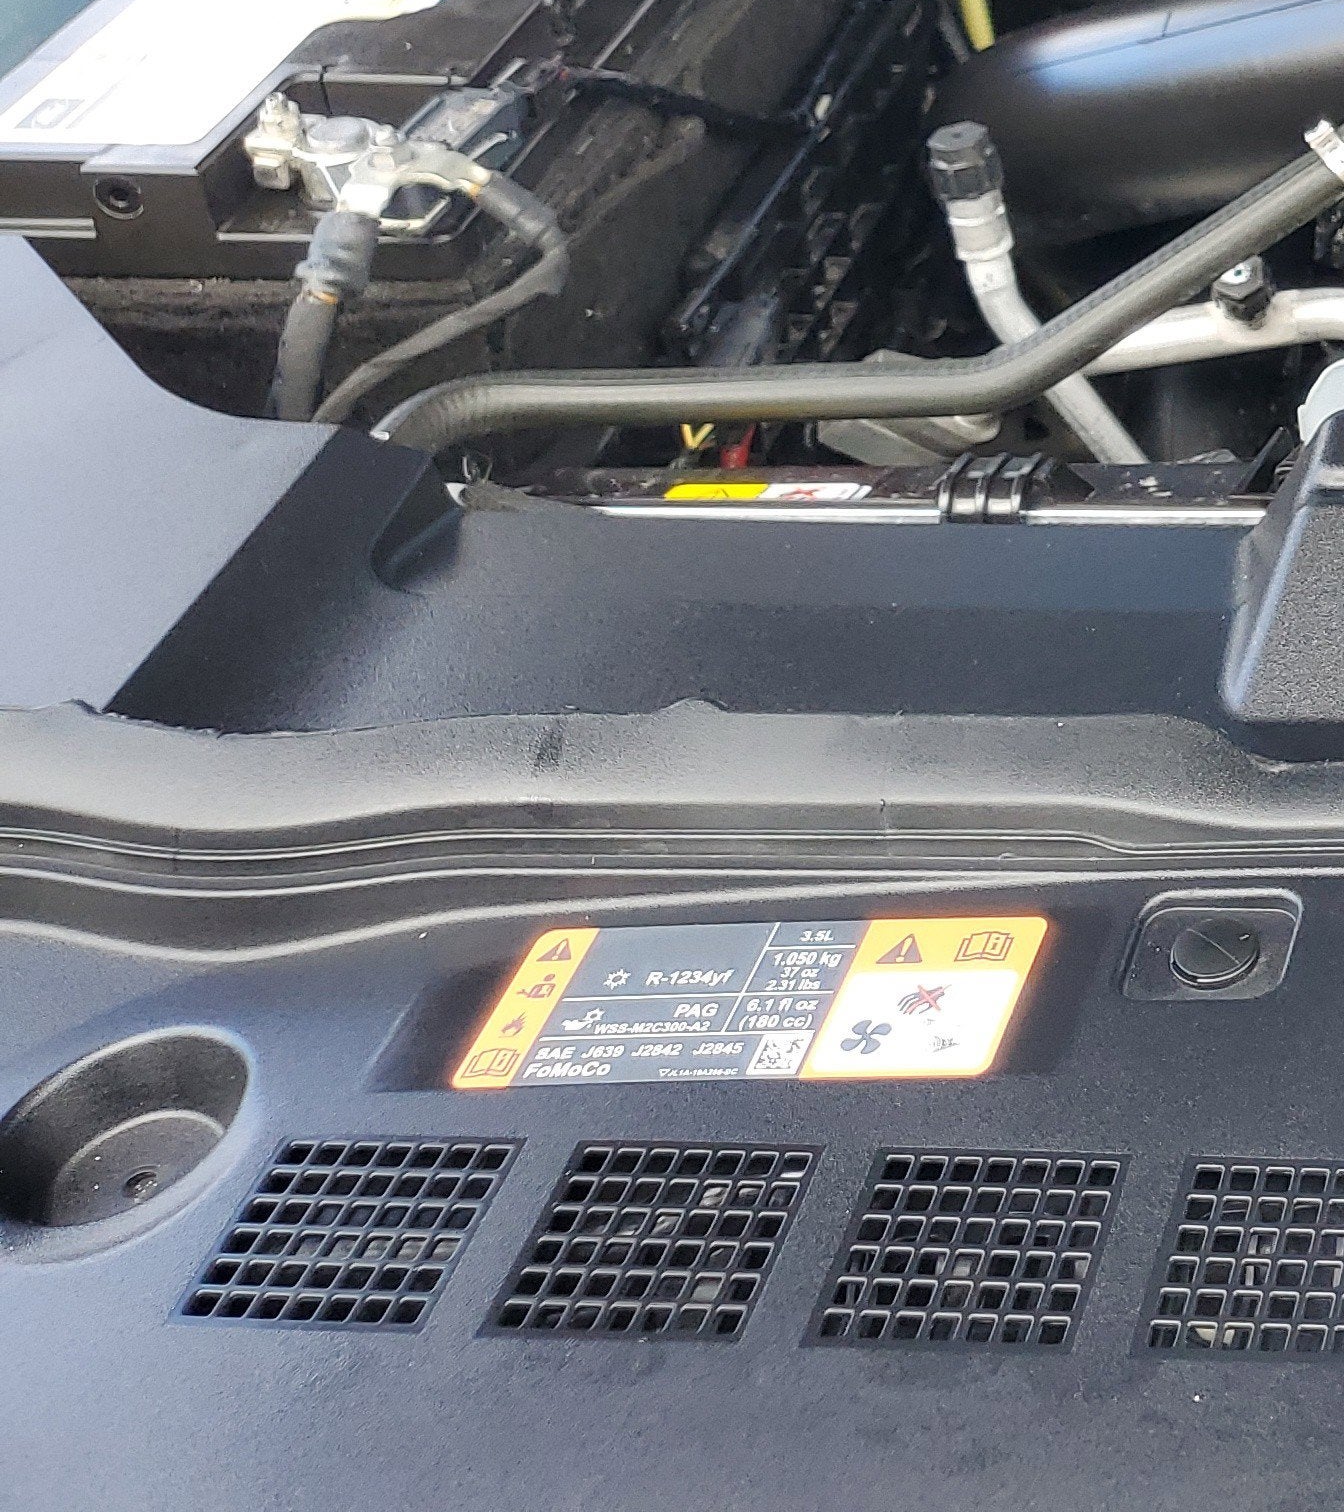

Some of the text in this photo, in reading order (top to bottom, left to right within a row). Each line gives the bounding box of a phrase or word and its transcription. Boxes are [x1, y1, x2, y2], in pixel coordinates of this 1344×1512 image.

[800, 930, 834, 942] 3.5L
[773, 952, 843, 968] 1.050 kg
[645, 968, 735, 988] R-1234yf
[780, 967, 821, 979] 37 oz
[765, 979, 822, 991] 2.31 lbs
[673, 1002, 721, 1019] PAG
[745, 997, 820, 1013] 6.1 fl oz
[594, 1020, 712, 1035] WSS-M2C300-A2
[738, 1013, 814, 1032] (180 cc)
[534, 1041, 746, 1061] SAE J639 J2842 J2845
[522, 1060, 613, 1080] FoMoCo
